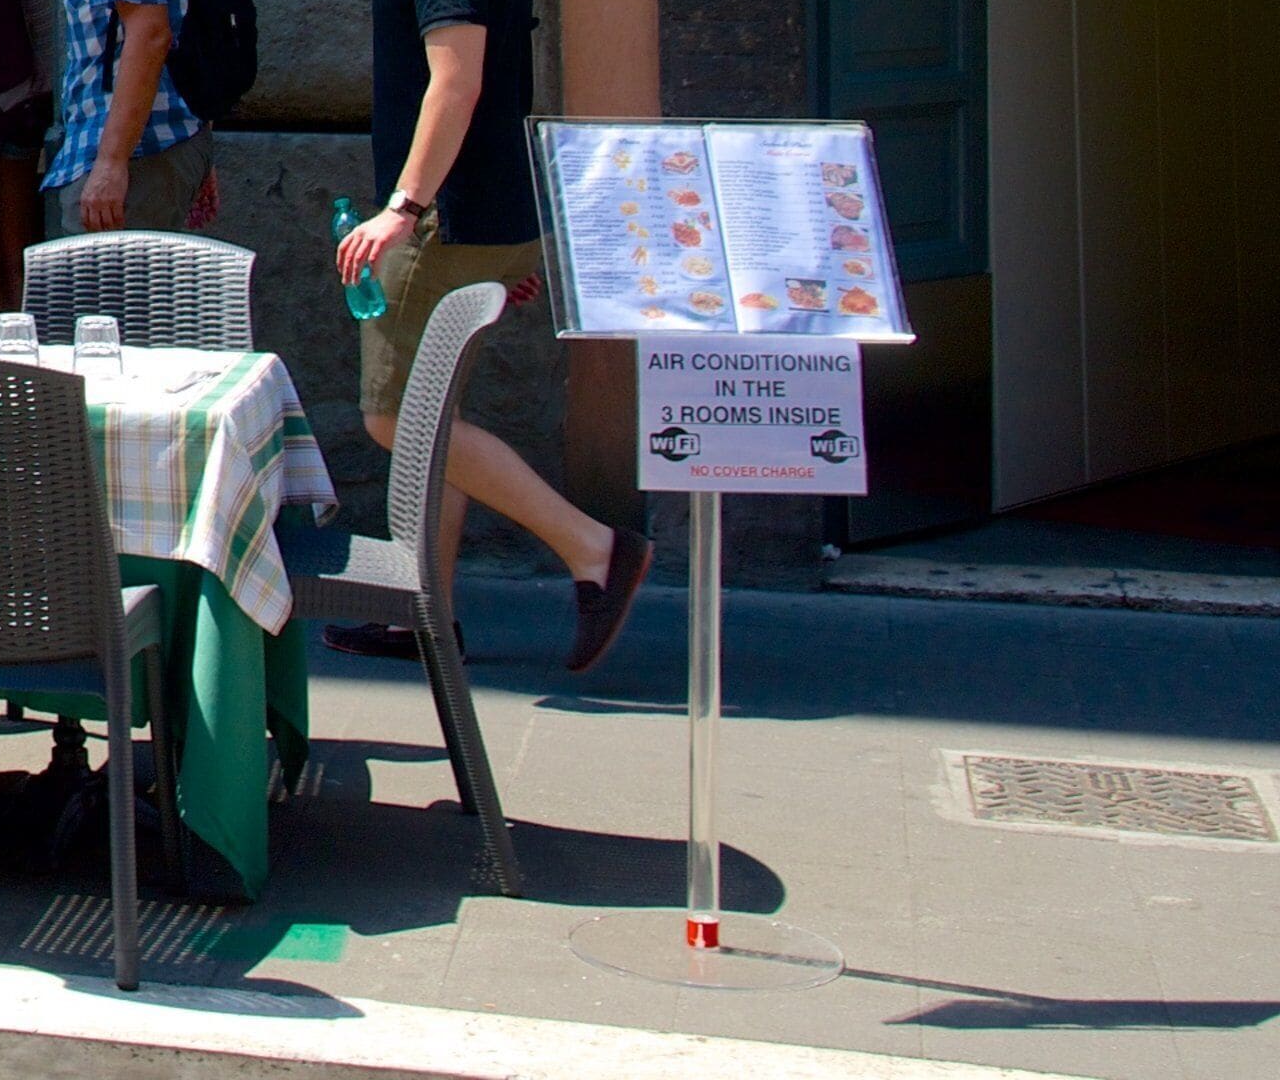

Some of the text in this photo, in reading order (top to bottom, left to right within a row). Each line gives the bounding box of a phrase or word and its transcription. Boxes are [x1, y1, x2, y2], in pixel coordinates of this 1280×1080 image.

[648, 353, 851, 372] AIR CONDITIONING
[715, 380, 786, 398] IN THE
[661, 405, 841, 425] 3 ROOMS INSIDE
[691, 466, 815, 479] NO COVER CHARGE
